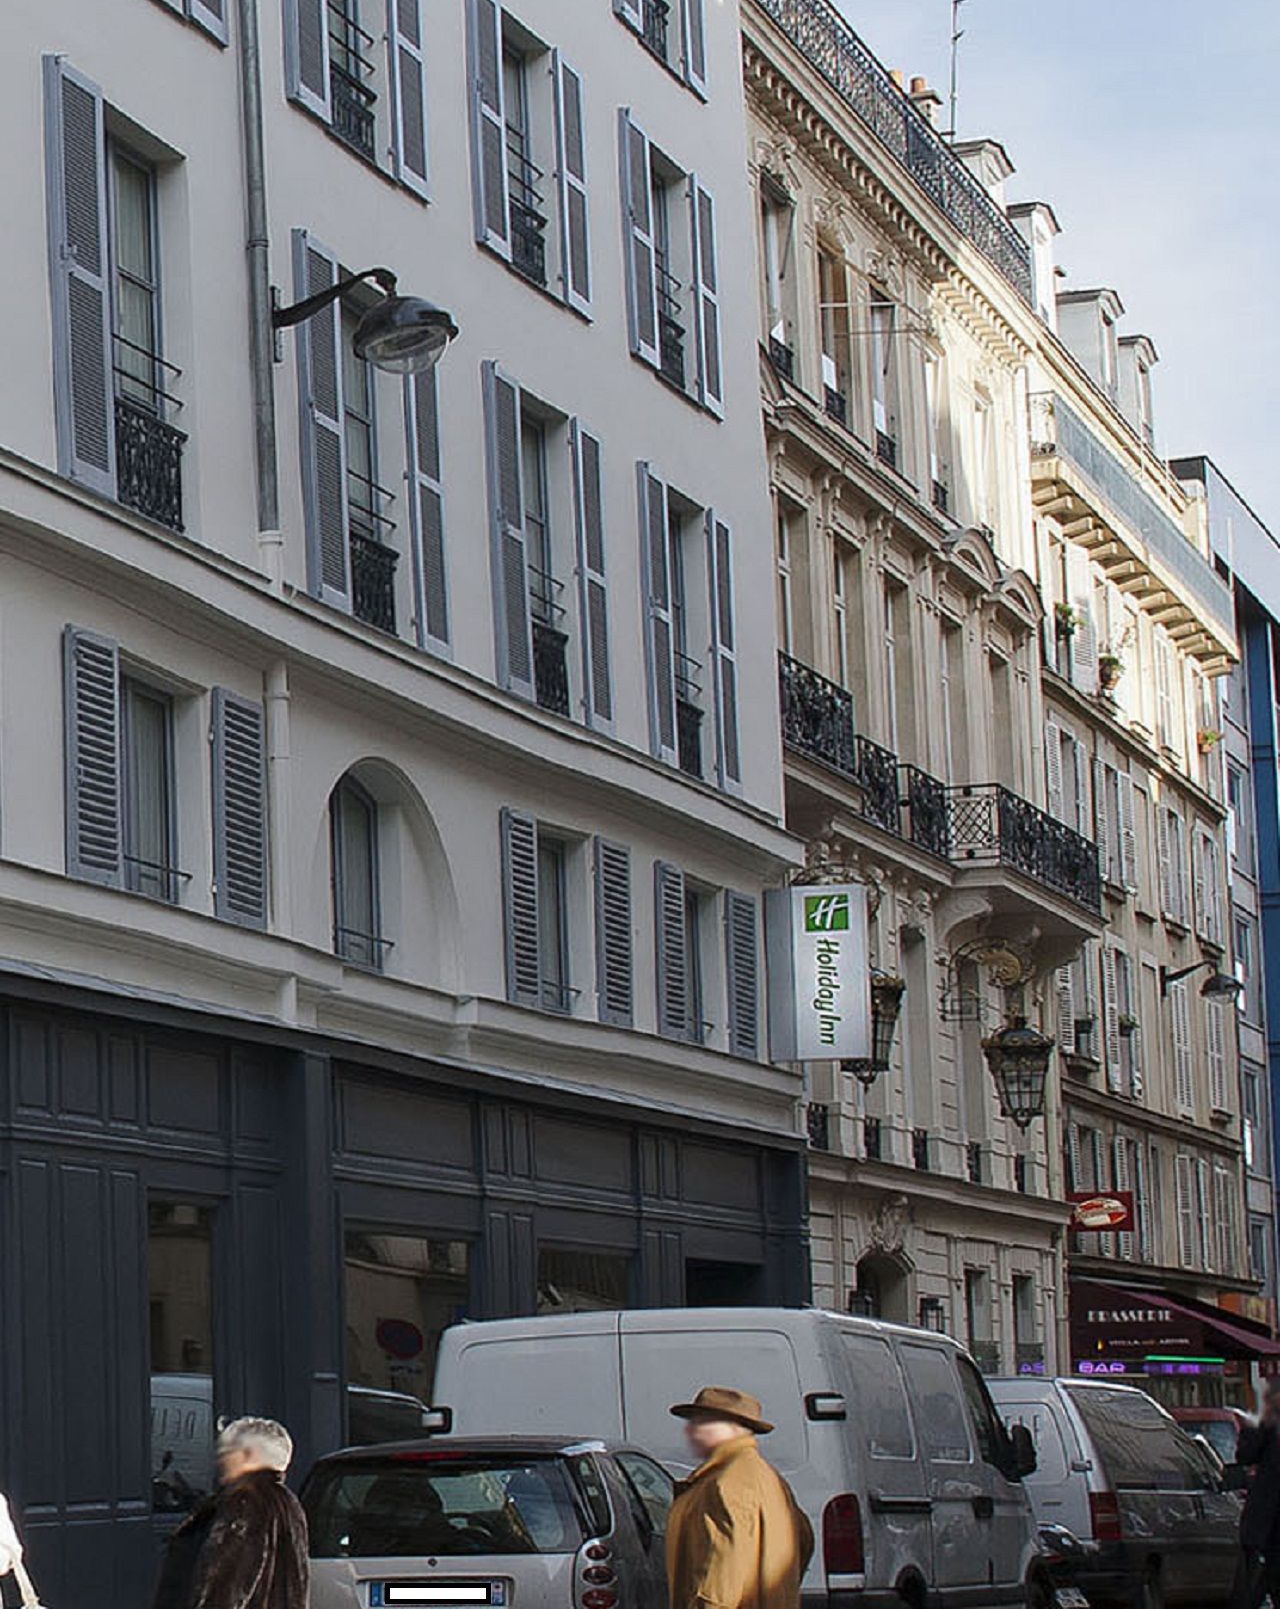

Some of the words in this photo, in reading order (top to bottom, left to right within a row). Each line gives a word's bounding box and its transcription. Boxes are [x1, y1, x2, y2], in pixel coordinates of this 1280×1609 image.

[813, 938, 841, 1012] Holiday
[819, 1014, 841, 1046] Inn
[1087, 1310, 1175, 1323] BRASSERIE
[1078, 1361, 1126, 1374] BAR
